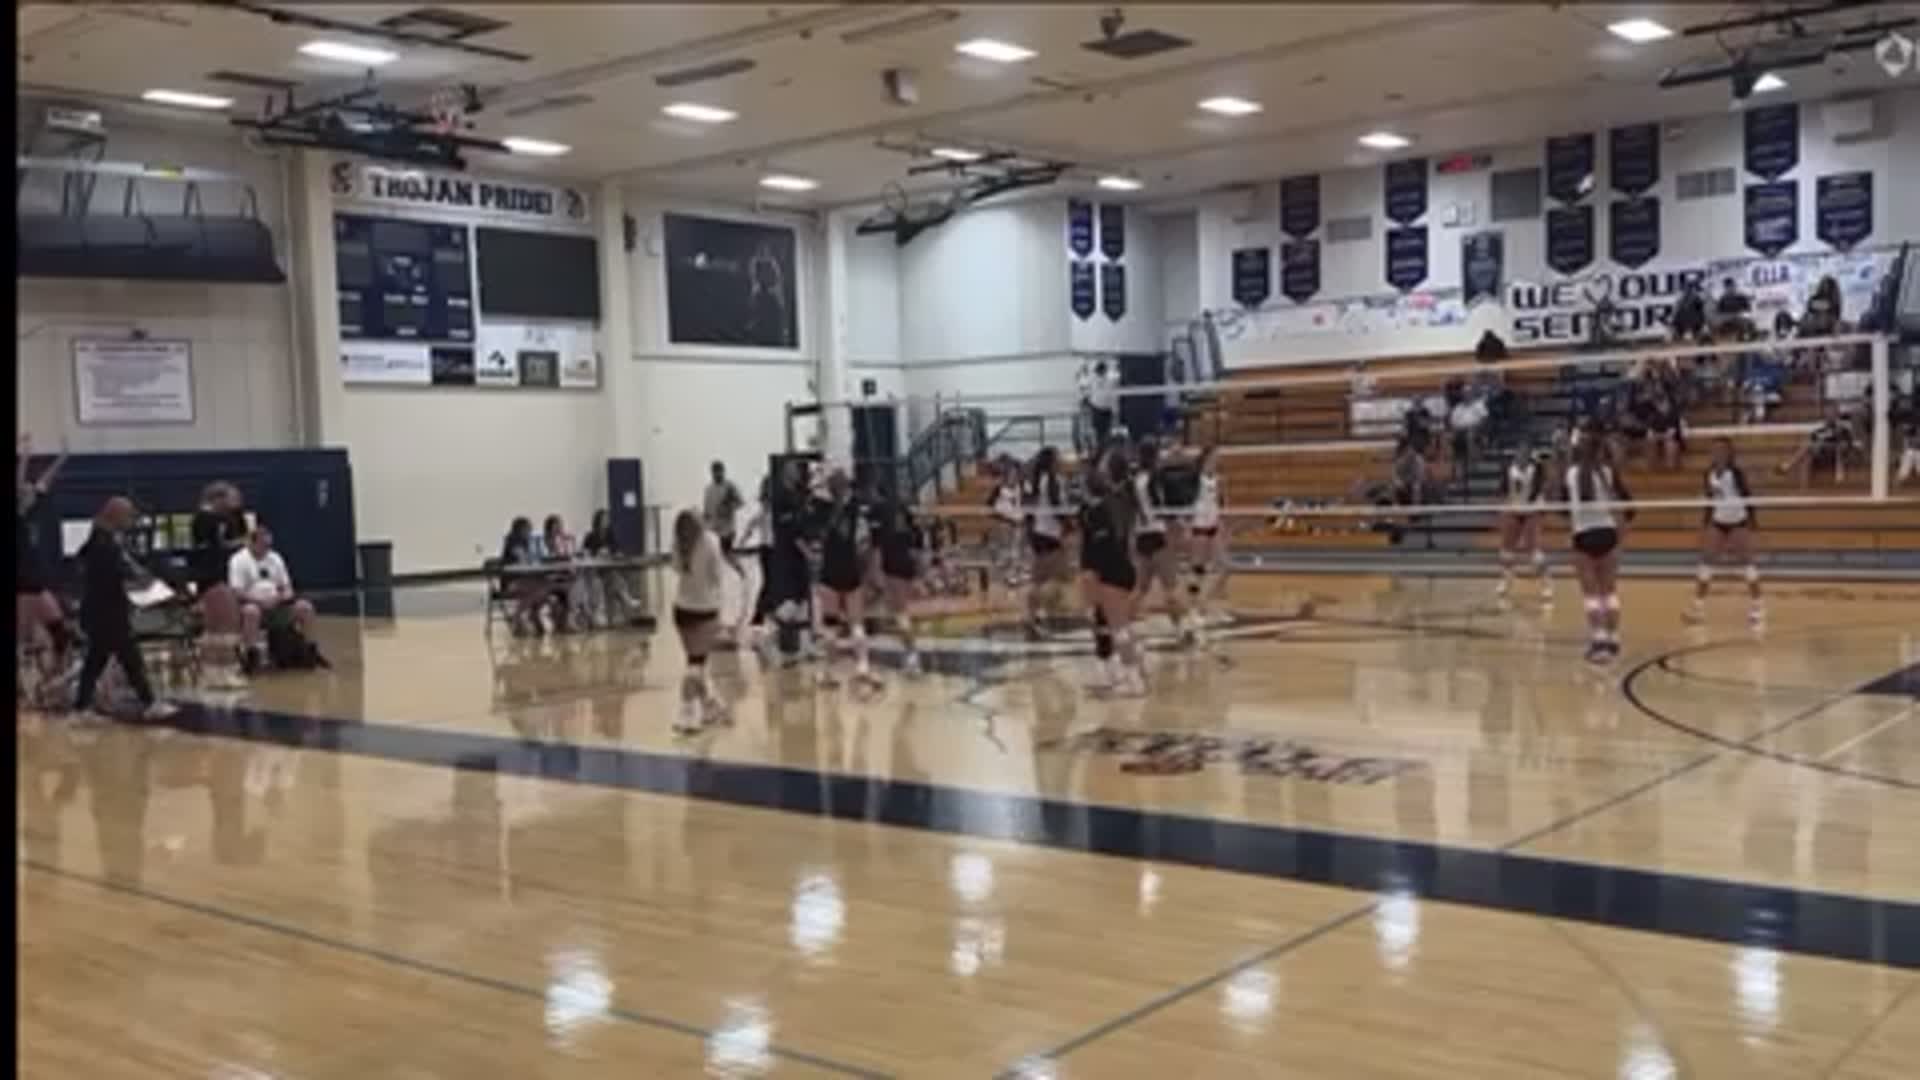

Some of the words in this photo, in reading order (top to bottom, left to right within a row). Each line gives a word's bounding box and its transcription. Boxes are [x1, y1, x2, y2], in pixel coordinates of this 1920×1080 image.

[369, 174, 473, 206] TROJAN
[1513, 284, 1574, 309] WE
[1619, 270, 1705, 299] OUR
